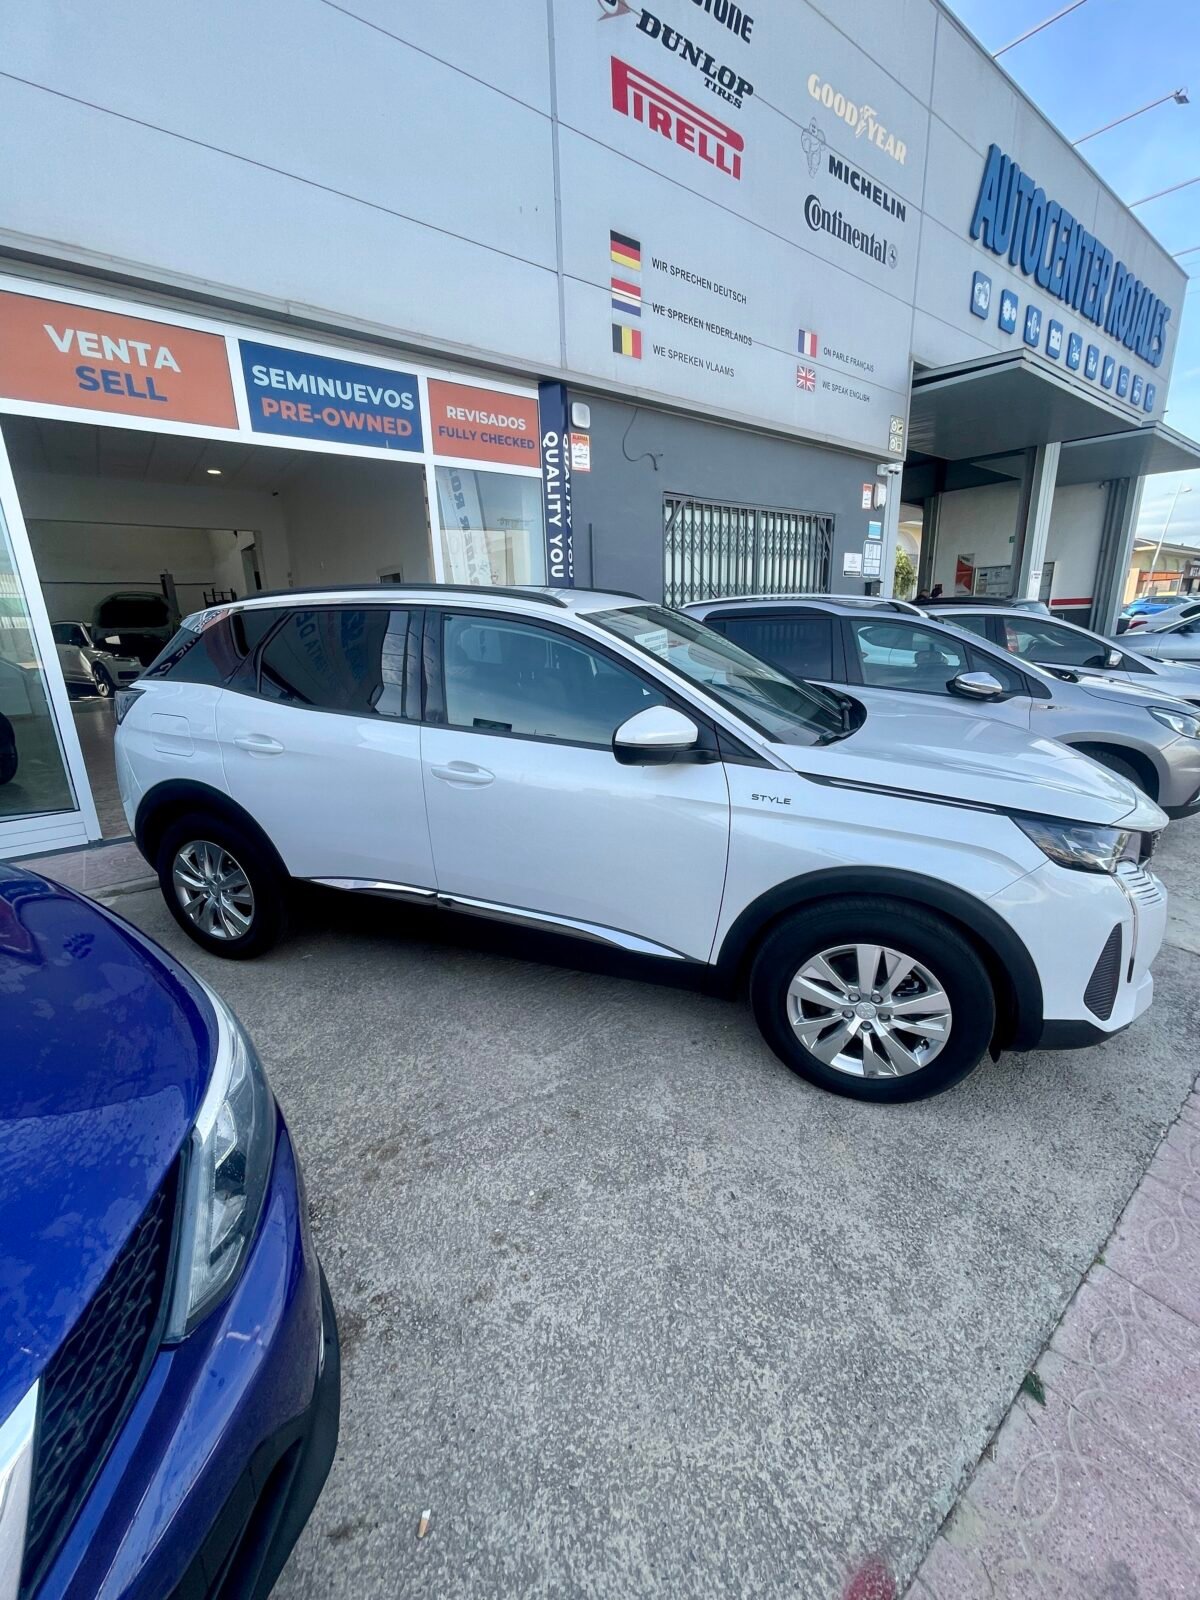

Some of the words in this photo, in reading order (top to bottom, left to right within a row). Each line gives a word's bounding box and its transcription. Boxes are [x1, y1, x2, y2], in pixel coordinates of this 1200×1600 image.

[636, 8, 754, 97] DUNLOP
[704, 77, 743, 109] TIRES
[611, 55, 745, 181] PIRELLI
[807, 73, 907, 165] GOODYEAR
[829, 154, 906, 222] MICHELIN
[804, 194, 887, 265] Continental
[970, 143, 1114, 326] AUTOCENTER
[1104, 261, 1173, 369] ROJALES
[652, 257, 668, 274] WIR
[670, 261, 712, 291] SPRECHEN
[713, 280, 747, 305] DEUTSCH
[652, 303, 665, 315] WE
[667, 308, 704, 330] SPREKEN
[705, 320, 752, 346] NEDERLANDS
[43, 324, 181, 374] VENTA
[653, 344, 666, 357] WE
[668, 348, 704, 369] SPREKEN
[705, 358, 735, 377] VLAAMS
[823, 347, 831, 357] ON
[832, 349, 849, 363] PARLE
[76, 365, 168, 402] SELL
[252, 364, 414, 411] SEMINUEVOS
[822, 381, 830, 391] WE
[831, 383, 848, 396] SPEAK
[849, 388, 870, 403] ENGLISH
[262, 397, 413, 437] PRE-OWNED
[438, 425, 477, 442] FULLY
[480, 432, 535, 451] CHECKED
[446, 405, 526, 431] REVISADOS
[543, 431, 561, 527] QUALITY
[549, 533, 564, 578] YOU
[751, 793, 792, 805] STYLE
